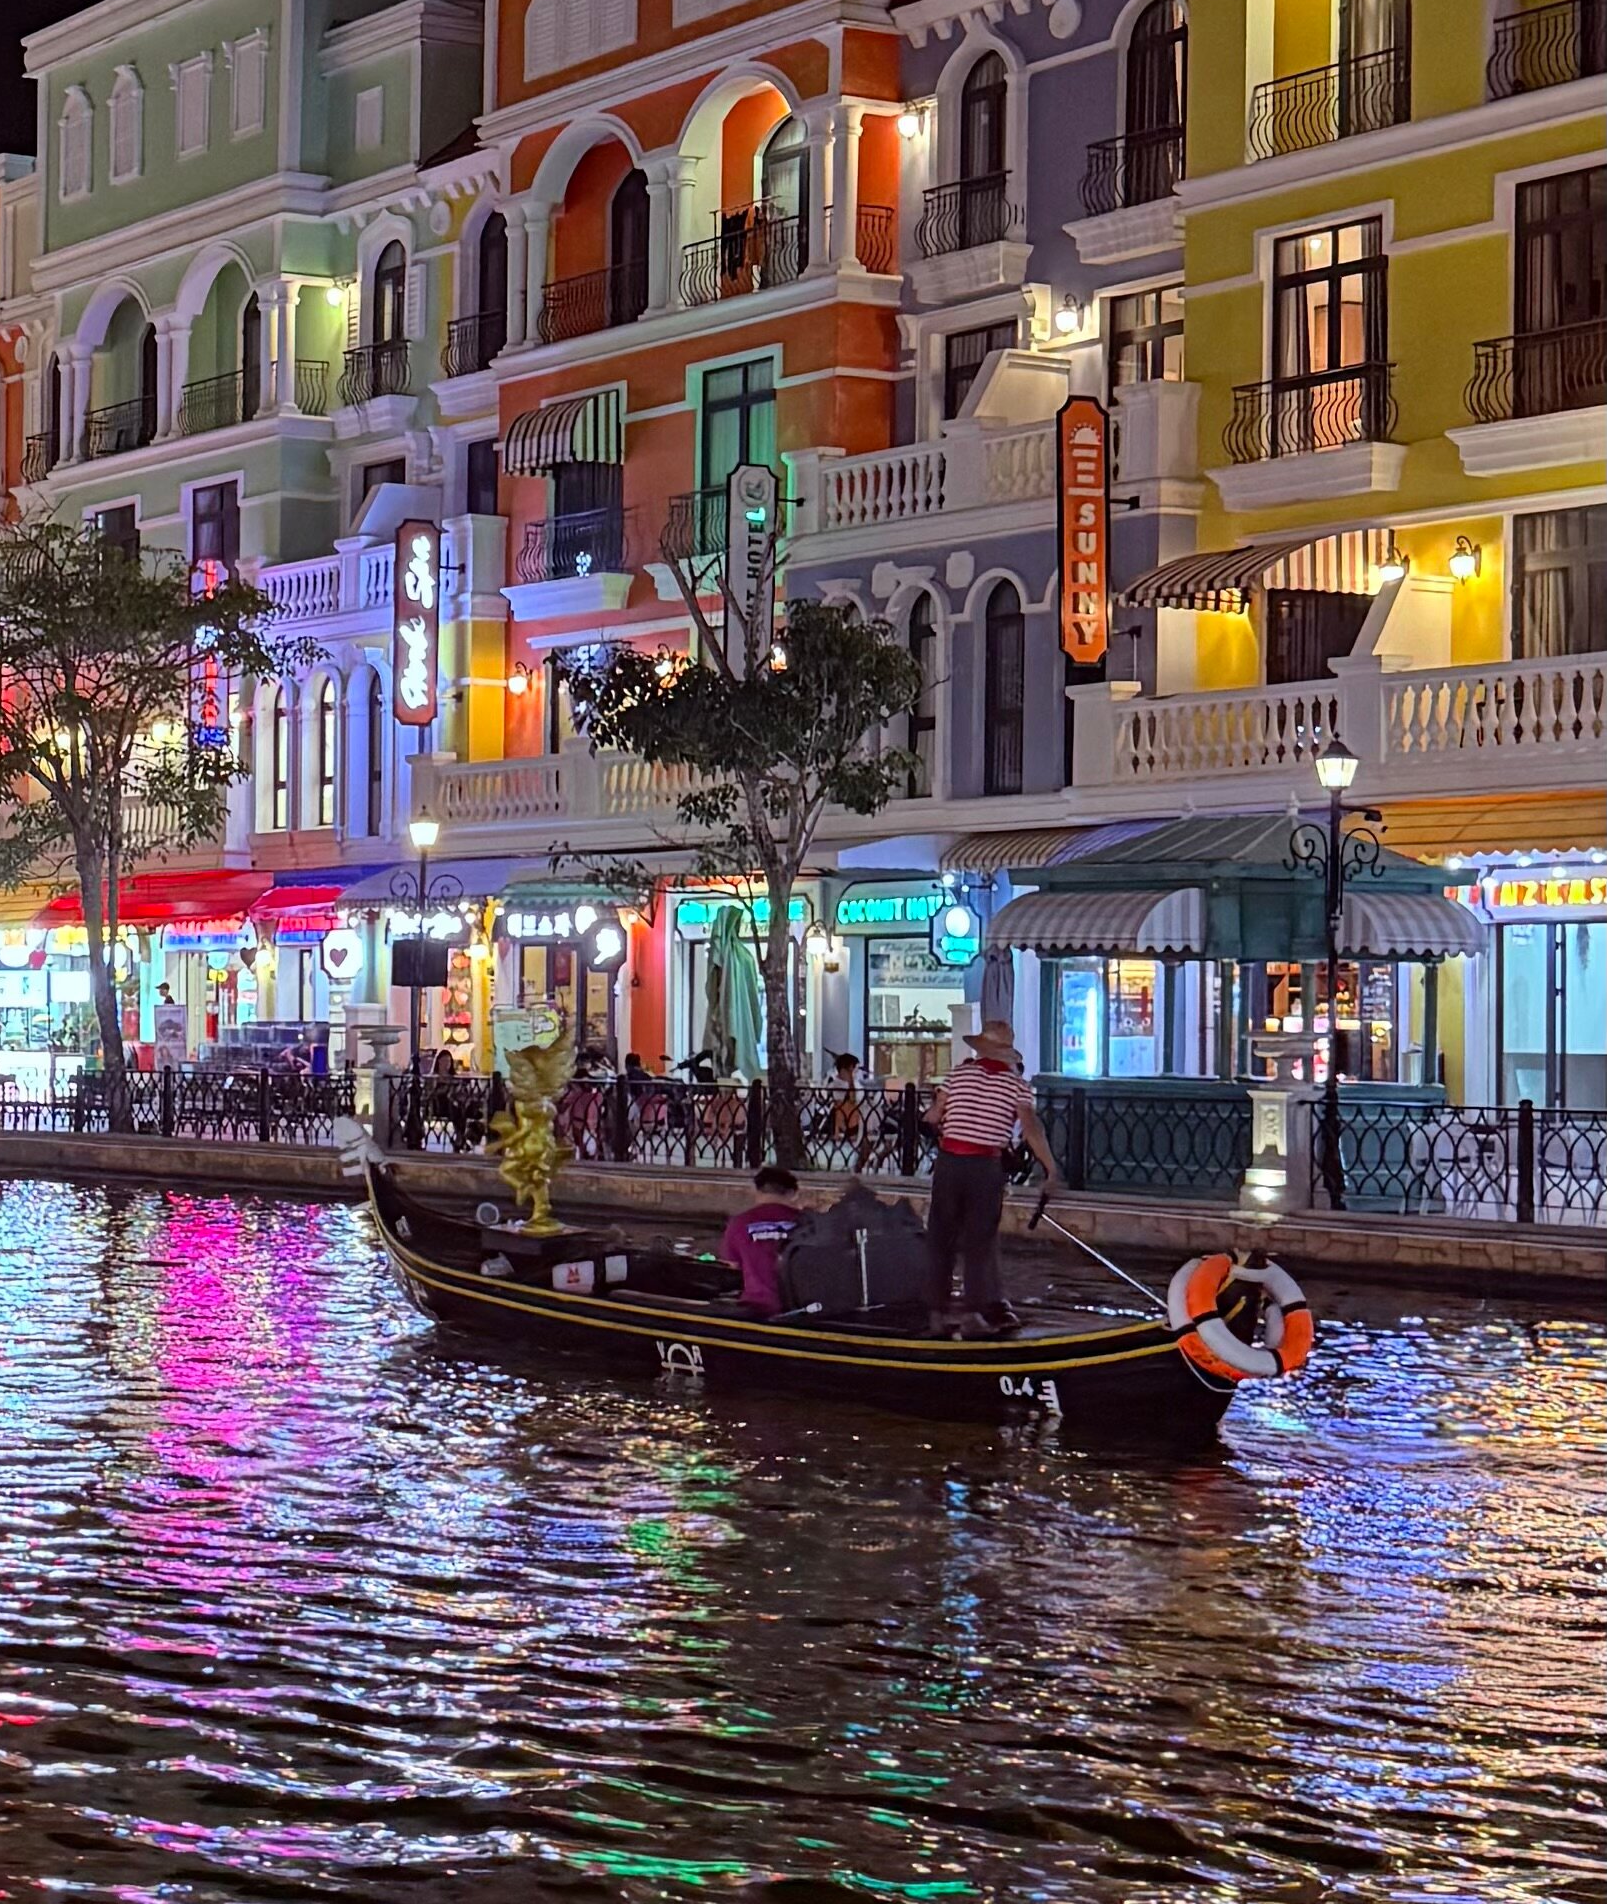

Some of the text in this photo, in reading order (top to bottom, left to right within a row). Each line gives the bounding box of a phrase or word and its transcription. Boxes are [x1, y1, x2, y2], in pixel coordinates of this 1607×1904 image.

[746, 507, 766, 580] HOTEL
[1072, 502, 1099, 646] SUNNY
[837, 897, 905, 925] COCONUT
